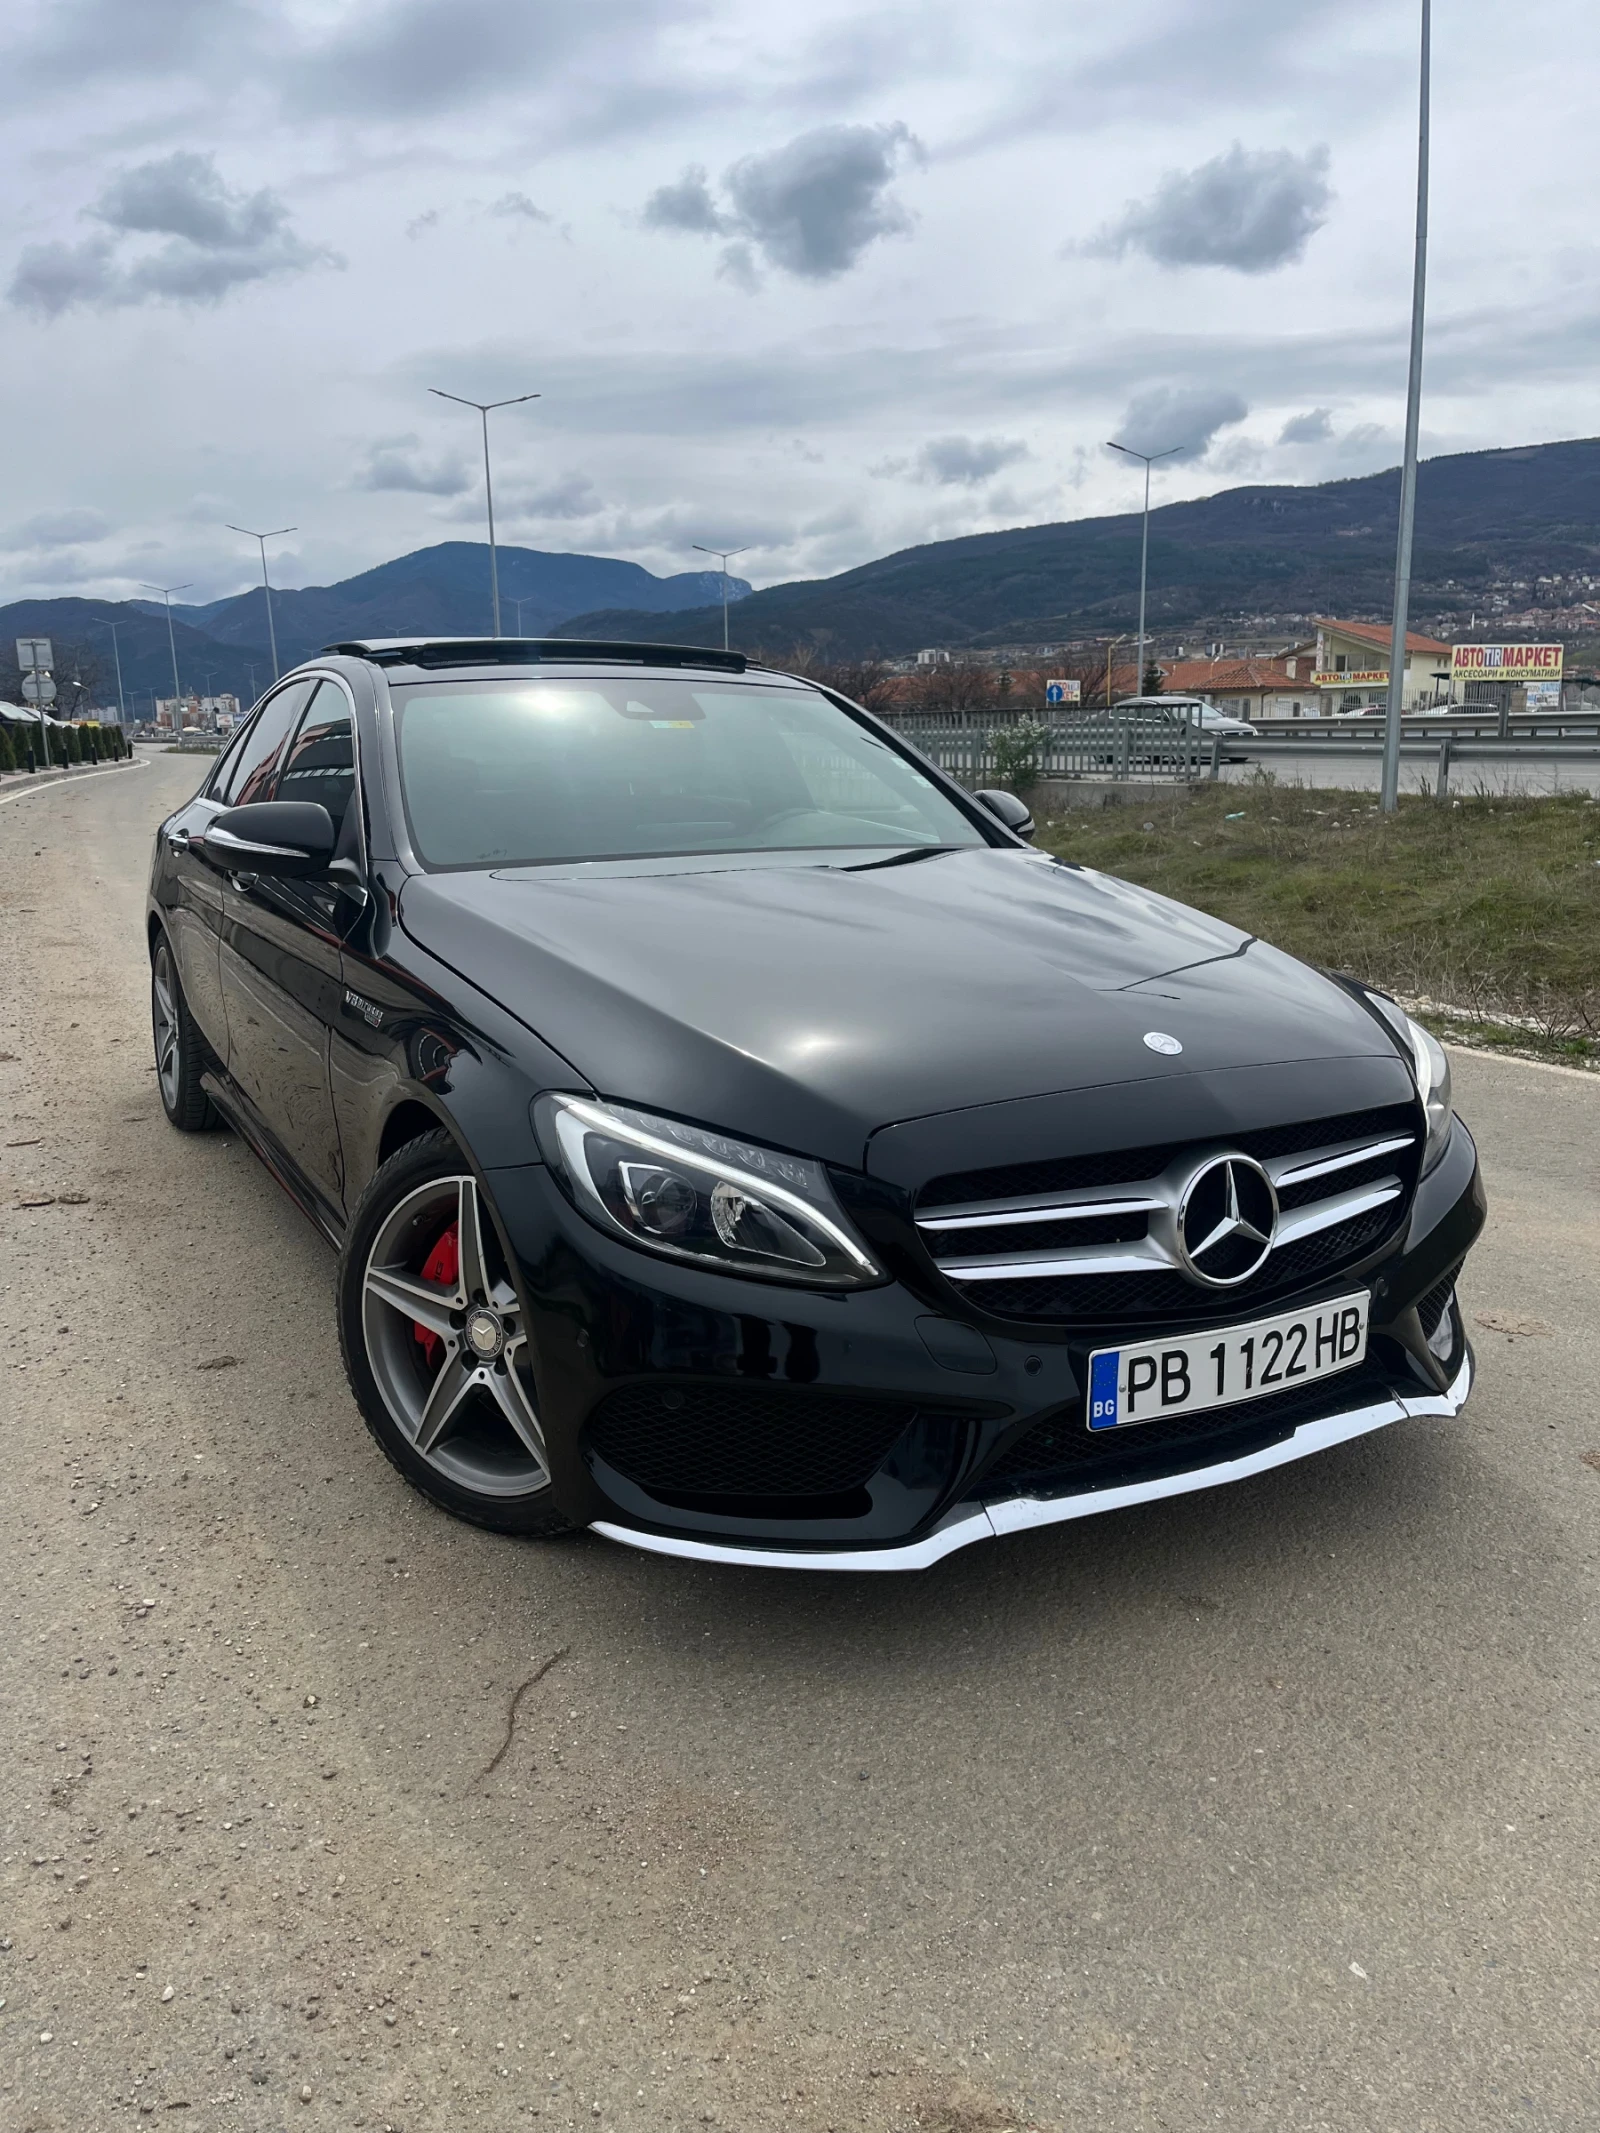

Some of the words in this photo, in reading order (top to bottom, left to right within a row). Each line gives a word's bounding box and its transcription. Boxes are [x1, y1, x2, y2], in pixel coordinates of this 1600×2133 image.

[1453, 669, 1498, 678] АКСЕСОАРИ
[1506, 669, 1560, 678] КОНСУМАТИВИ
[1093, 1400, 1115, 1418] BG
